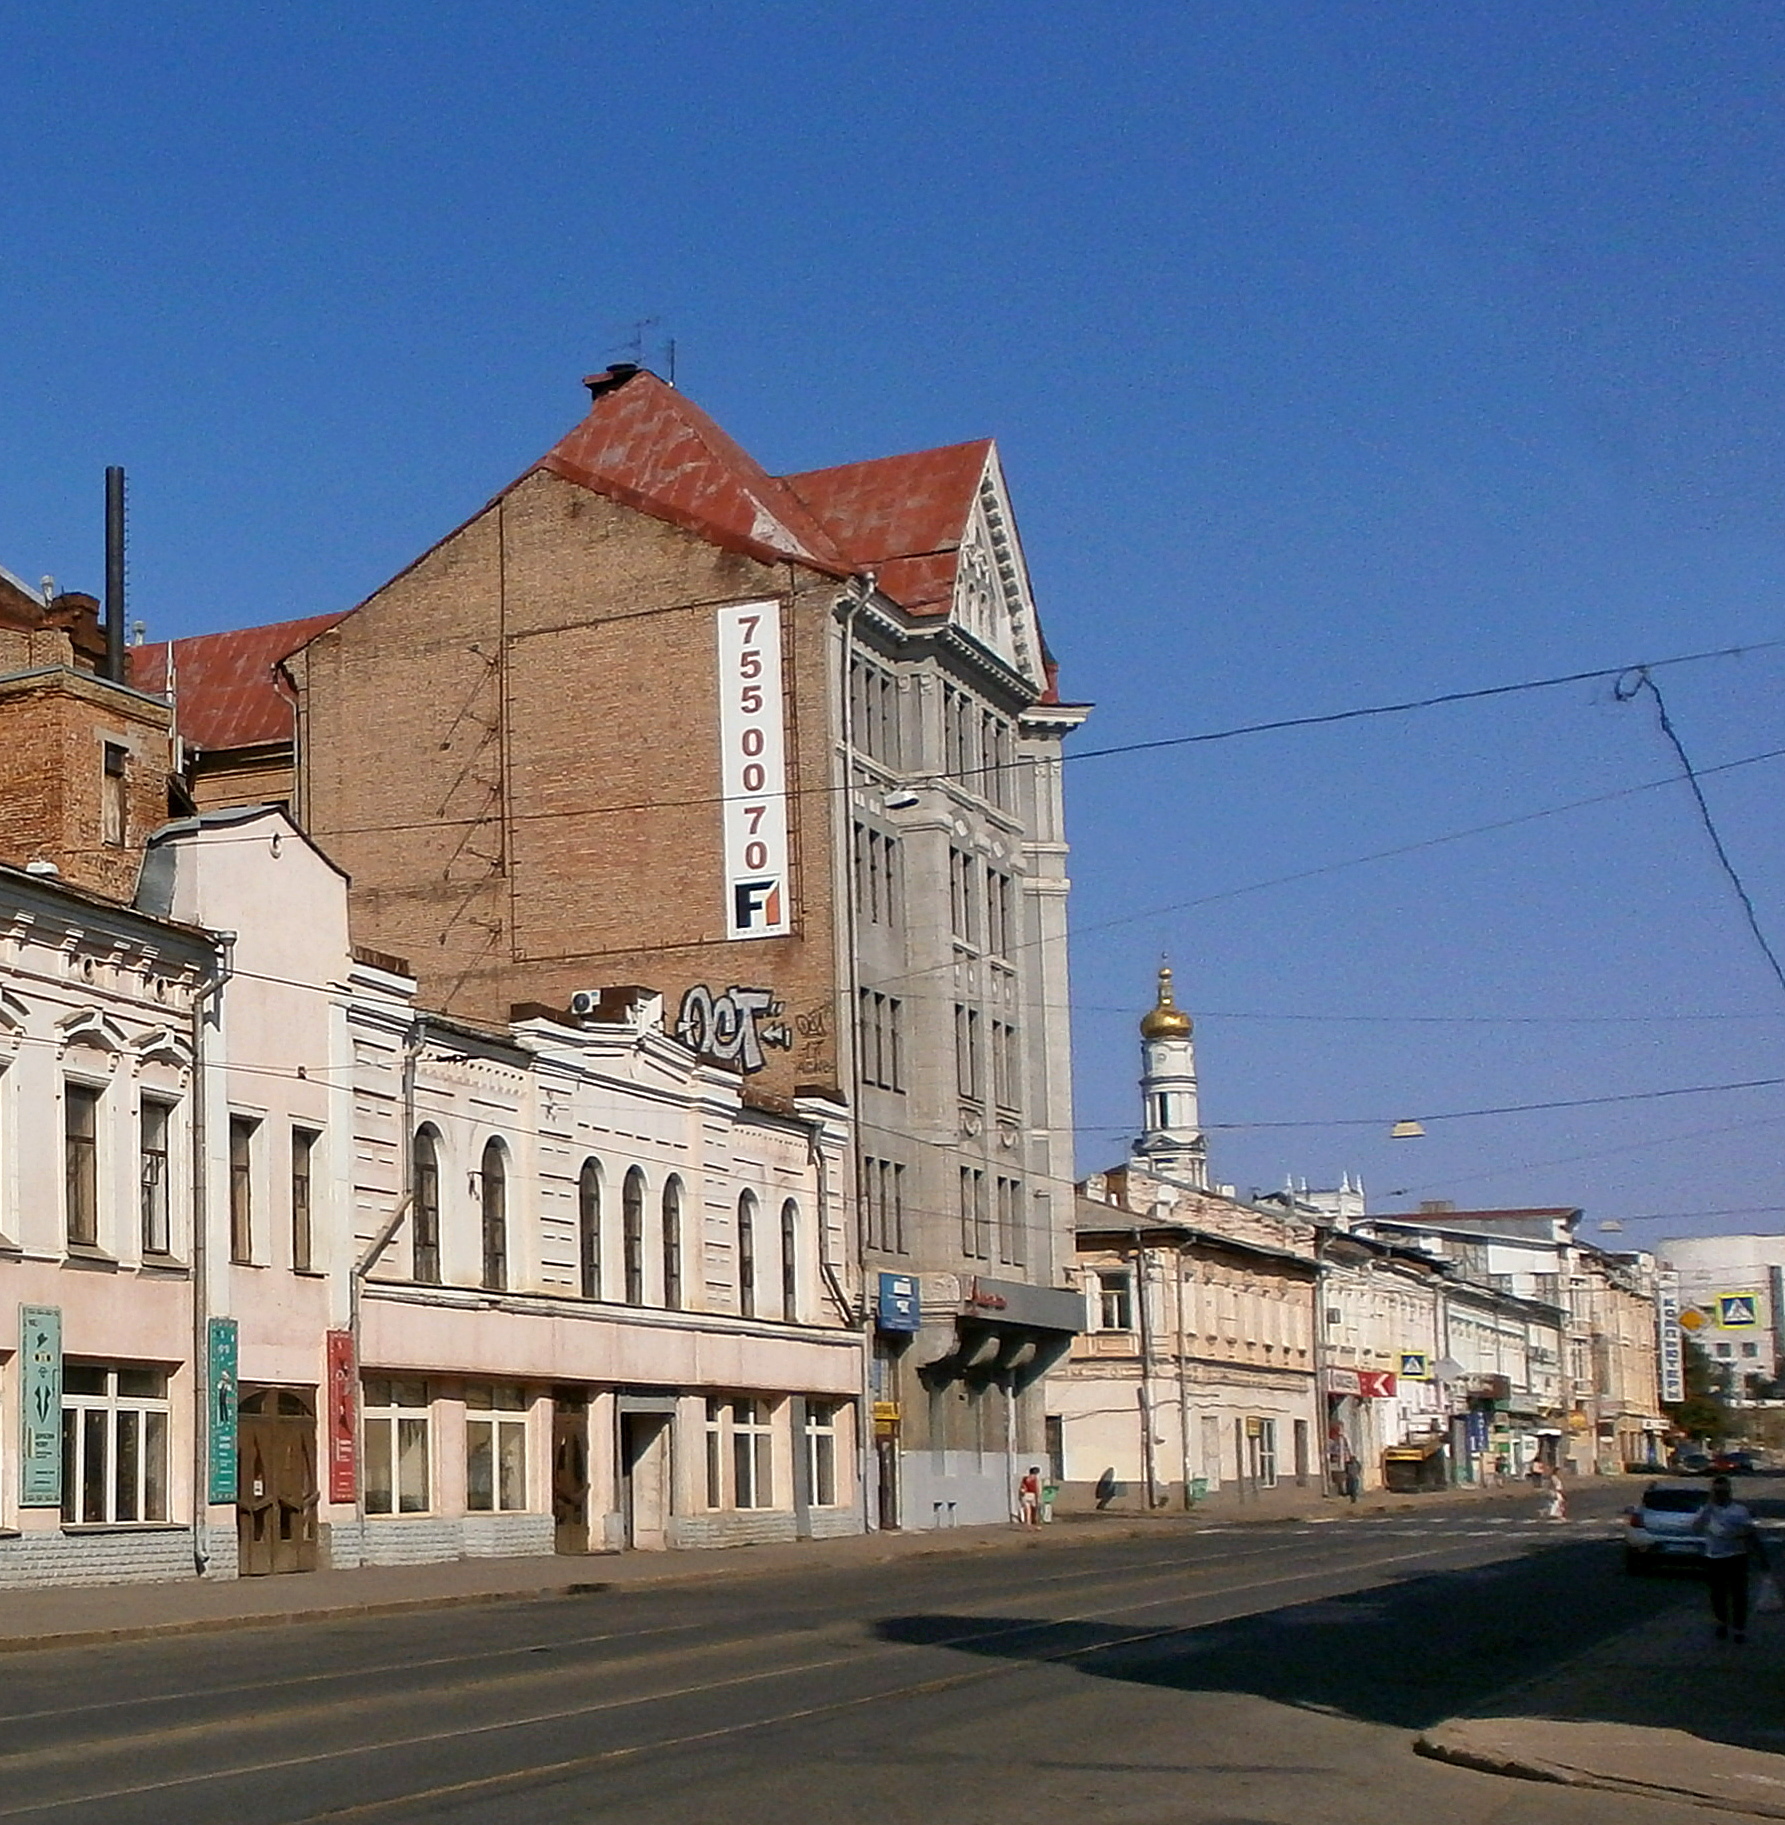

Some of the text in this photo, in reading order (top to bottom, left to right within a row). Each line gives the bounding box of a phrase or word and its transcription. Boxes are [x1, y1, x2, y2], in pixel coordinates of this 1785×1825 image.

[737, 615, 768, 870] 755 00 70
